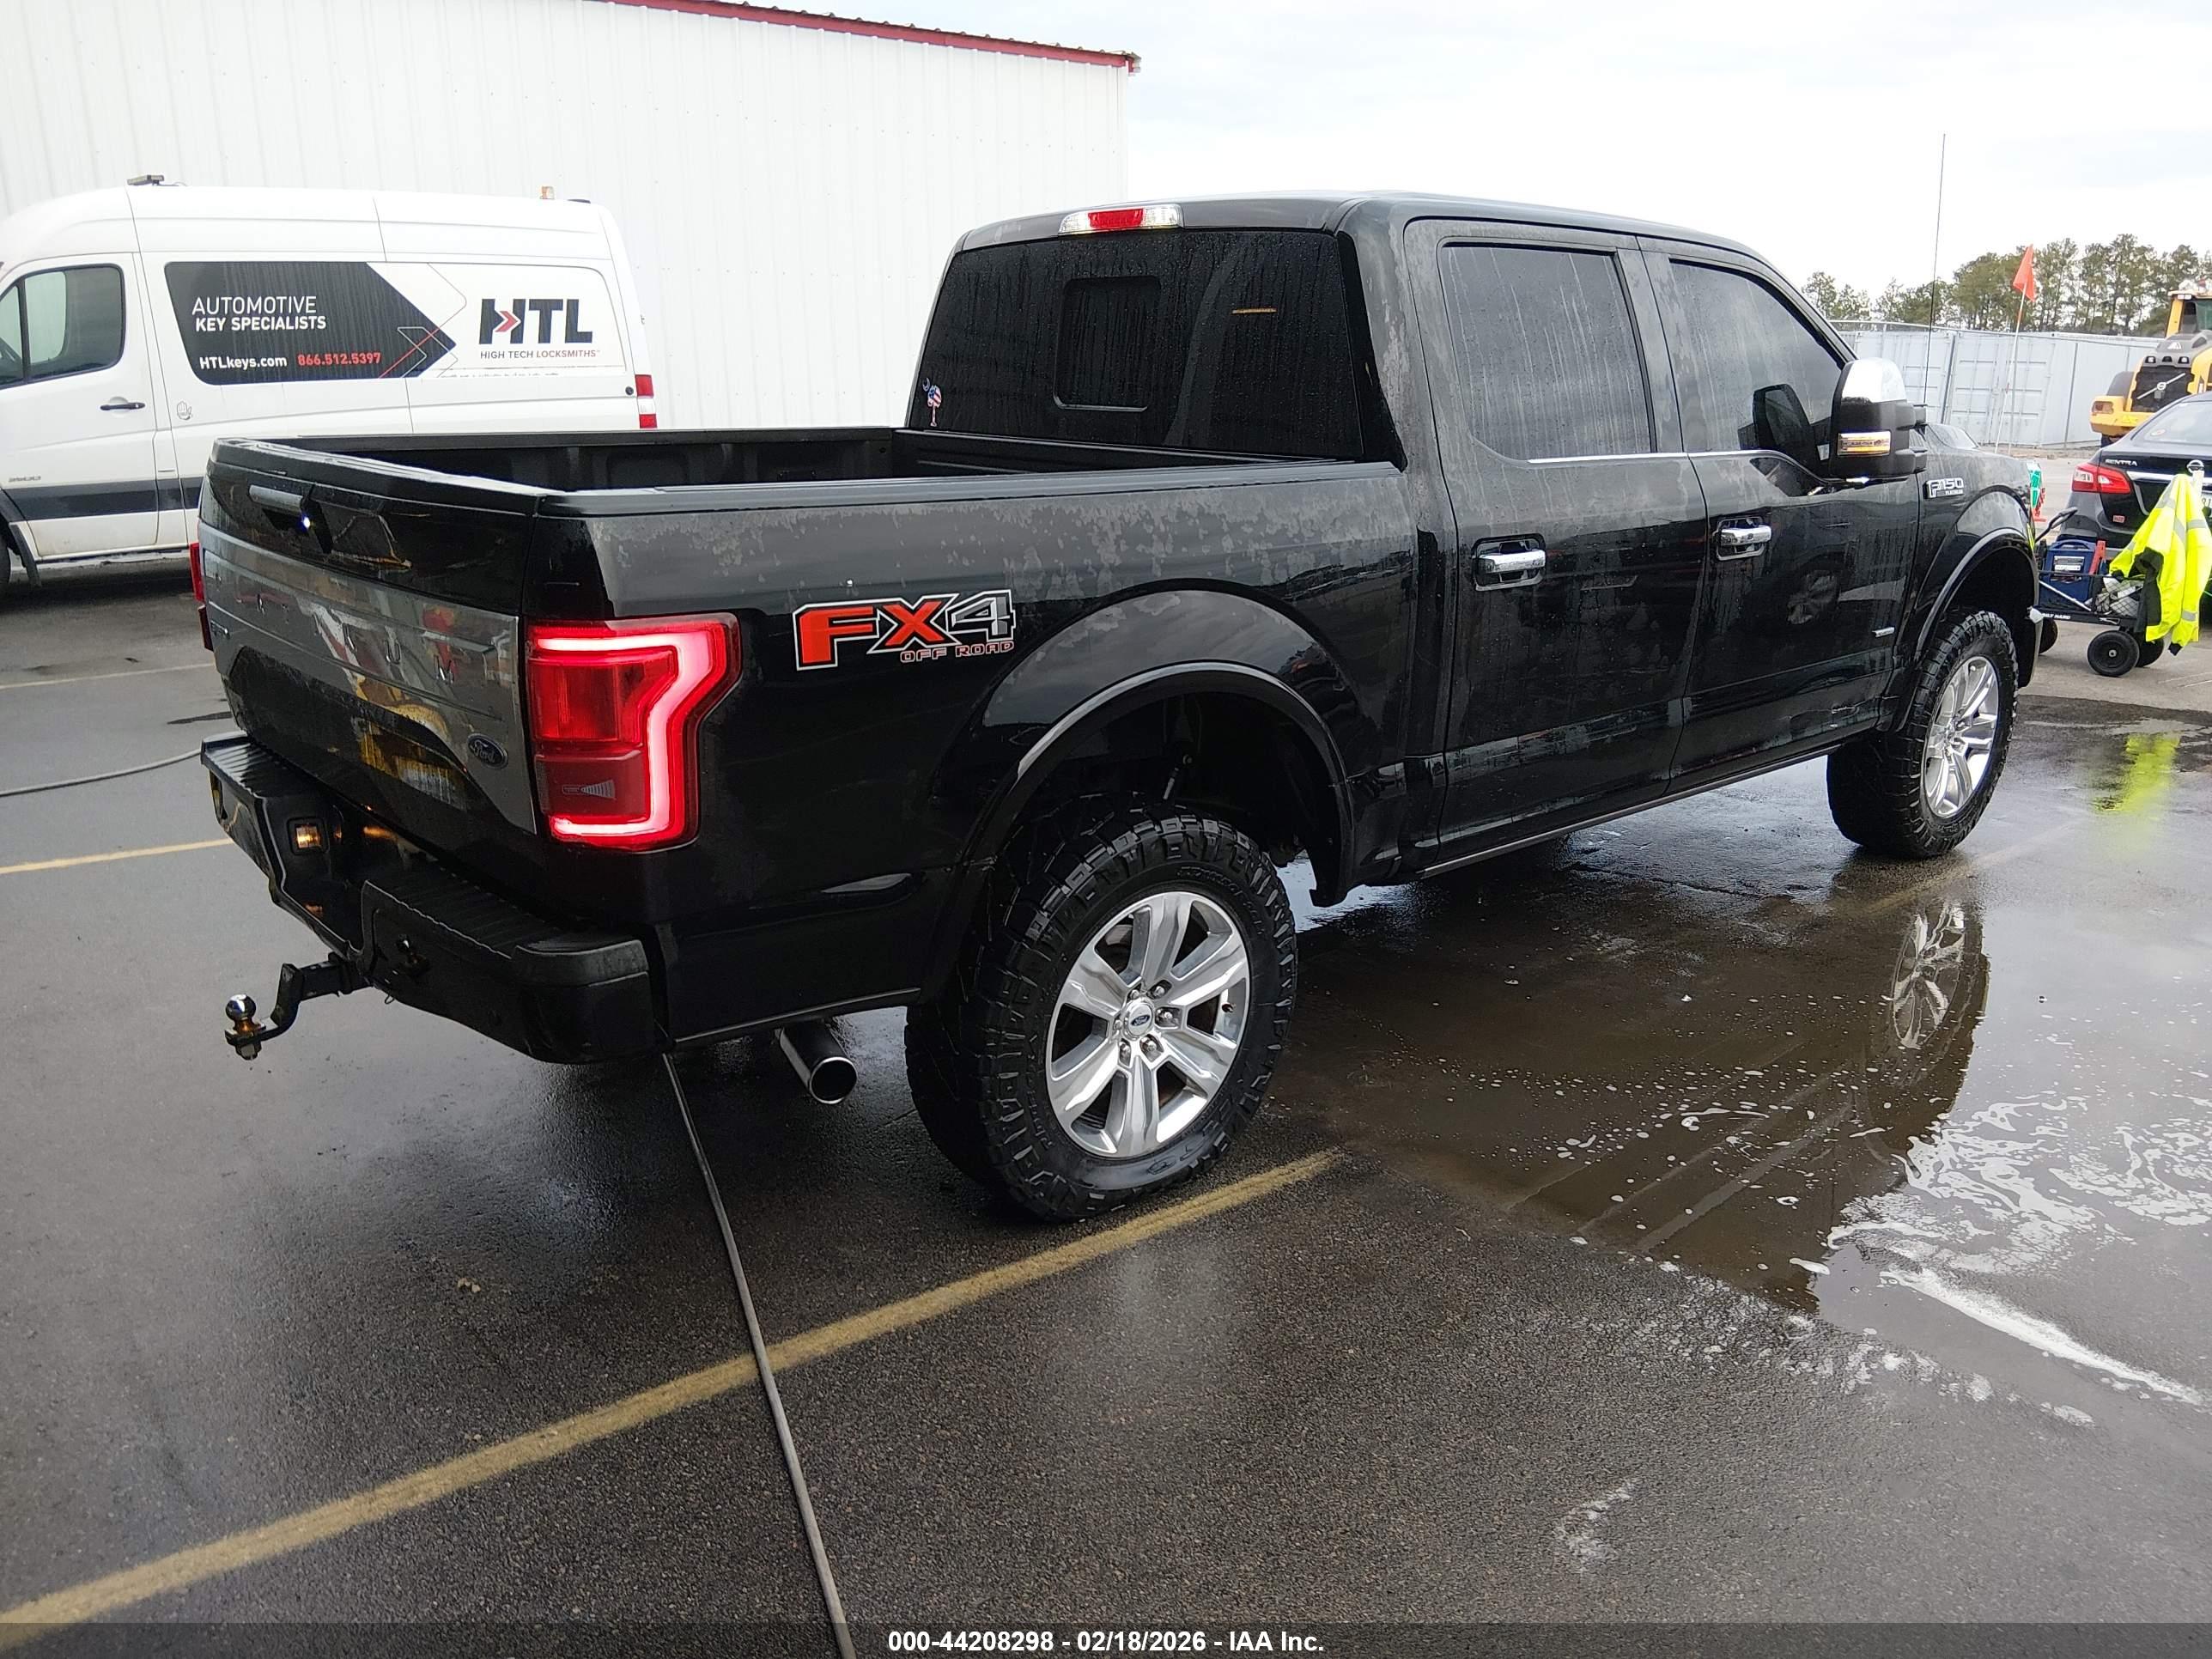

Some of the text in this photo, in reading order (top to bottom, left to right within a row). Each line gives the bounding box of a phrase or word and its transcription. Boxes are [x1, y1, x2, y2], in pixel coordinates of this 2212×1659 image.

[191, 295, 317, 316] AUTOMOTIVE
[195, 315, 326, 332] KEY SPECIALISTS
[478, 298, 592, 344] HTL
[199, 351, 381, 370] HTLkeys.com 866.512.5397
[480, 350, 505, 359] HIGH
[508, 349, 533, 359] TECH
[793, 589, 1016, 671] FX4
[900, 641, 1014, 663] OFF ROAD
